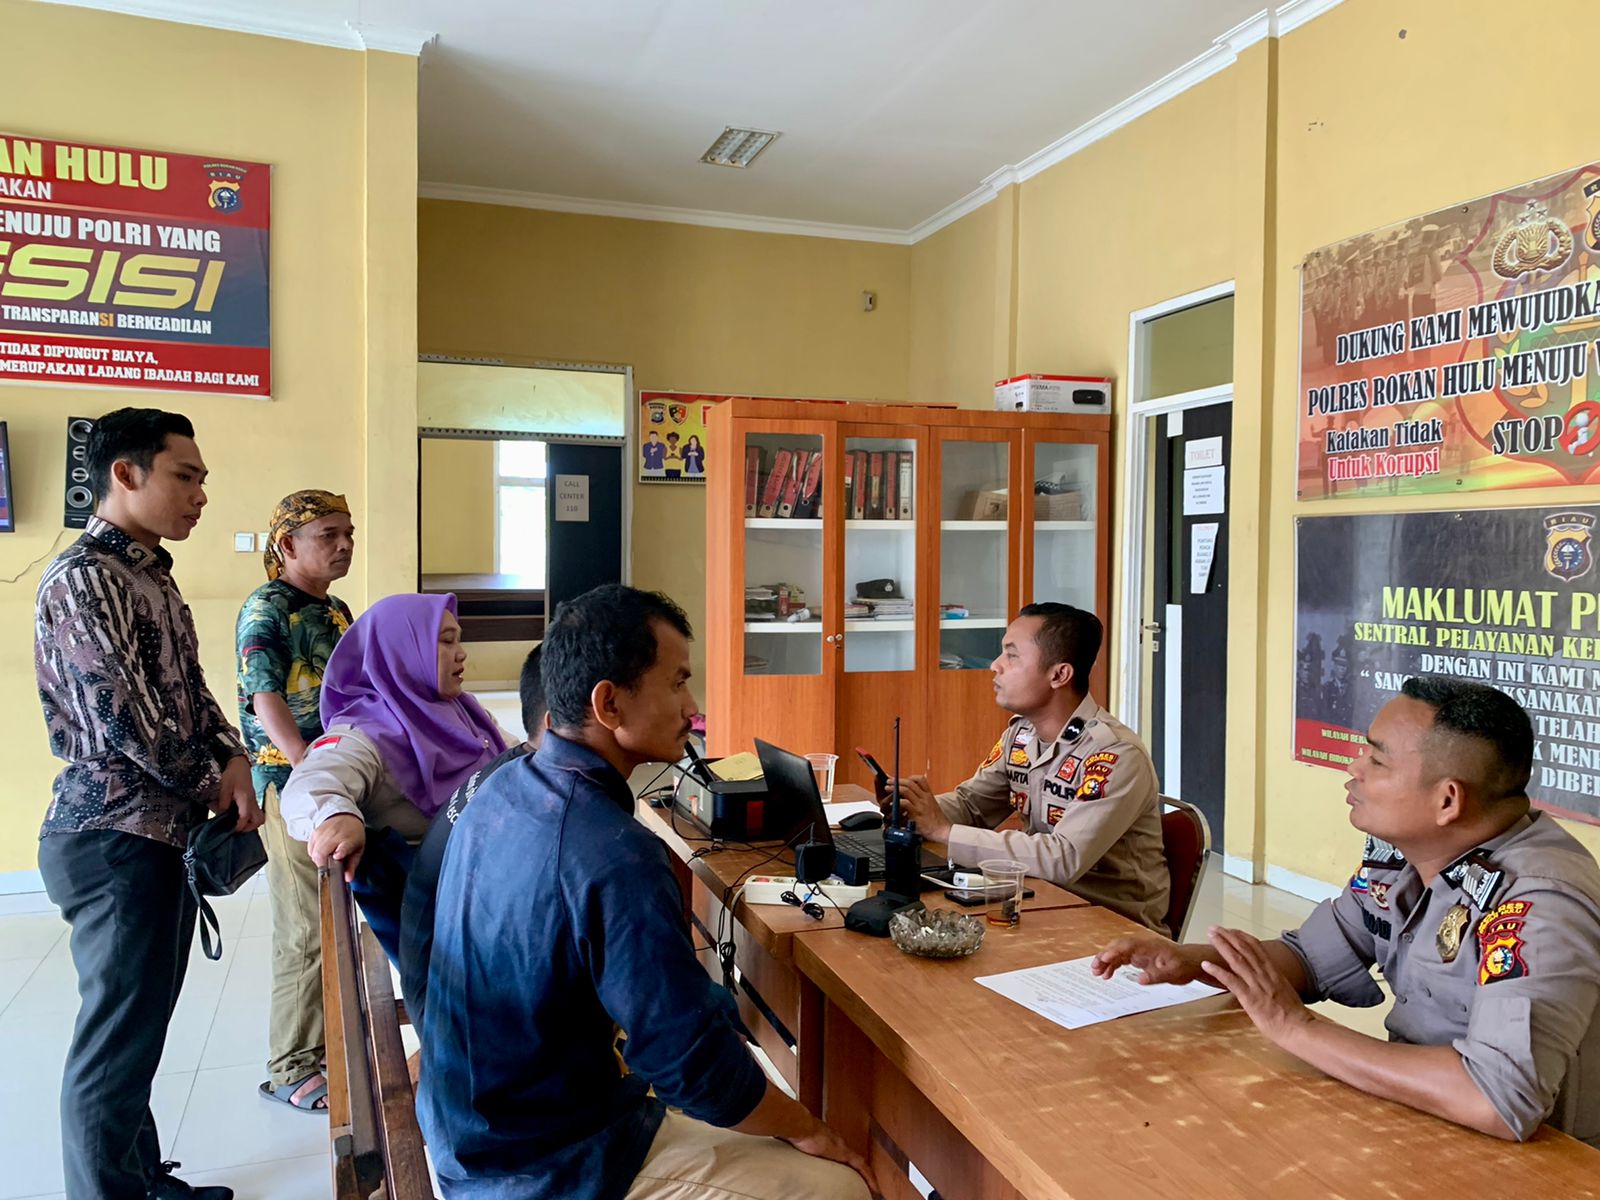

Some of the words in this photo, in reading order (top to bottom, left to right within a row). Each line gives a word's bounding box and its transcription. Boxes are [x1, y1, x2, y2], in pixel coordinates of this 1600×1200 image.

[55, 145, 168, 191] HULU
[0, 177, 51, 200] AKAN
[78, 217, 151, 246] POLRI
[156, 225, 221, 253] YANG
[0, 241, 226, 313] SISI
[1, 304, 114, 327] TRANSPARANSI
[117, 314, 212, 335] BERKEADILAN
[1336, 322, 1404, 364] DUKUNG
[1410, 310, 1462, 350] KAMI
[0, 341, 41, 357] TIDAK
[43, 345, 110, 362] DIPUNGUT
[111, 350, 159, 365] BIAYA,
[0, 359, 86, 376] MERUPAKAN
[88, 365, 141, 380] LADANG
[143, 369, 193, 384] IBADAH
[194, 372, 224, 385] BAGI
[226, 373, 260, 387] KAMI
[1308, 381, 1367, 416] POLRES
[1373, 369, 1436, 406] ROKAN
[1442, 358, 1494, 397] HULU
[1502, 343, 1588, 388] MENUJU
[1327, 427, 1388, 453] Katakan
[1394, 418, 1443, 445] Tidak
[1493, 416, 1563, 455] STOP
[1328, 457, 1370, 480] Untuk
[1375, 449, 1439, 477] Korupsi
[564, 480, 580, 488] CALL
[1382, 586, 1558, 629] MAKLUMAT
[1571, 591, 1600, 631] P
[1354, 622, 1430, 647] SENTRAL
[1436, 627, 1554, 657] PELAYANAN
[1421, 653, 1491, 679] DENGAN
[1497, 660, 1525, 682] INI
[1531, 663, 1585, 690] KAMI
[1536, 715, 1600, 745] TELAH
[1043, 779, 1075, 801] POLR
